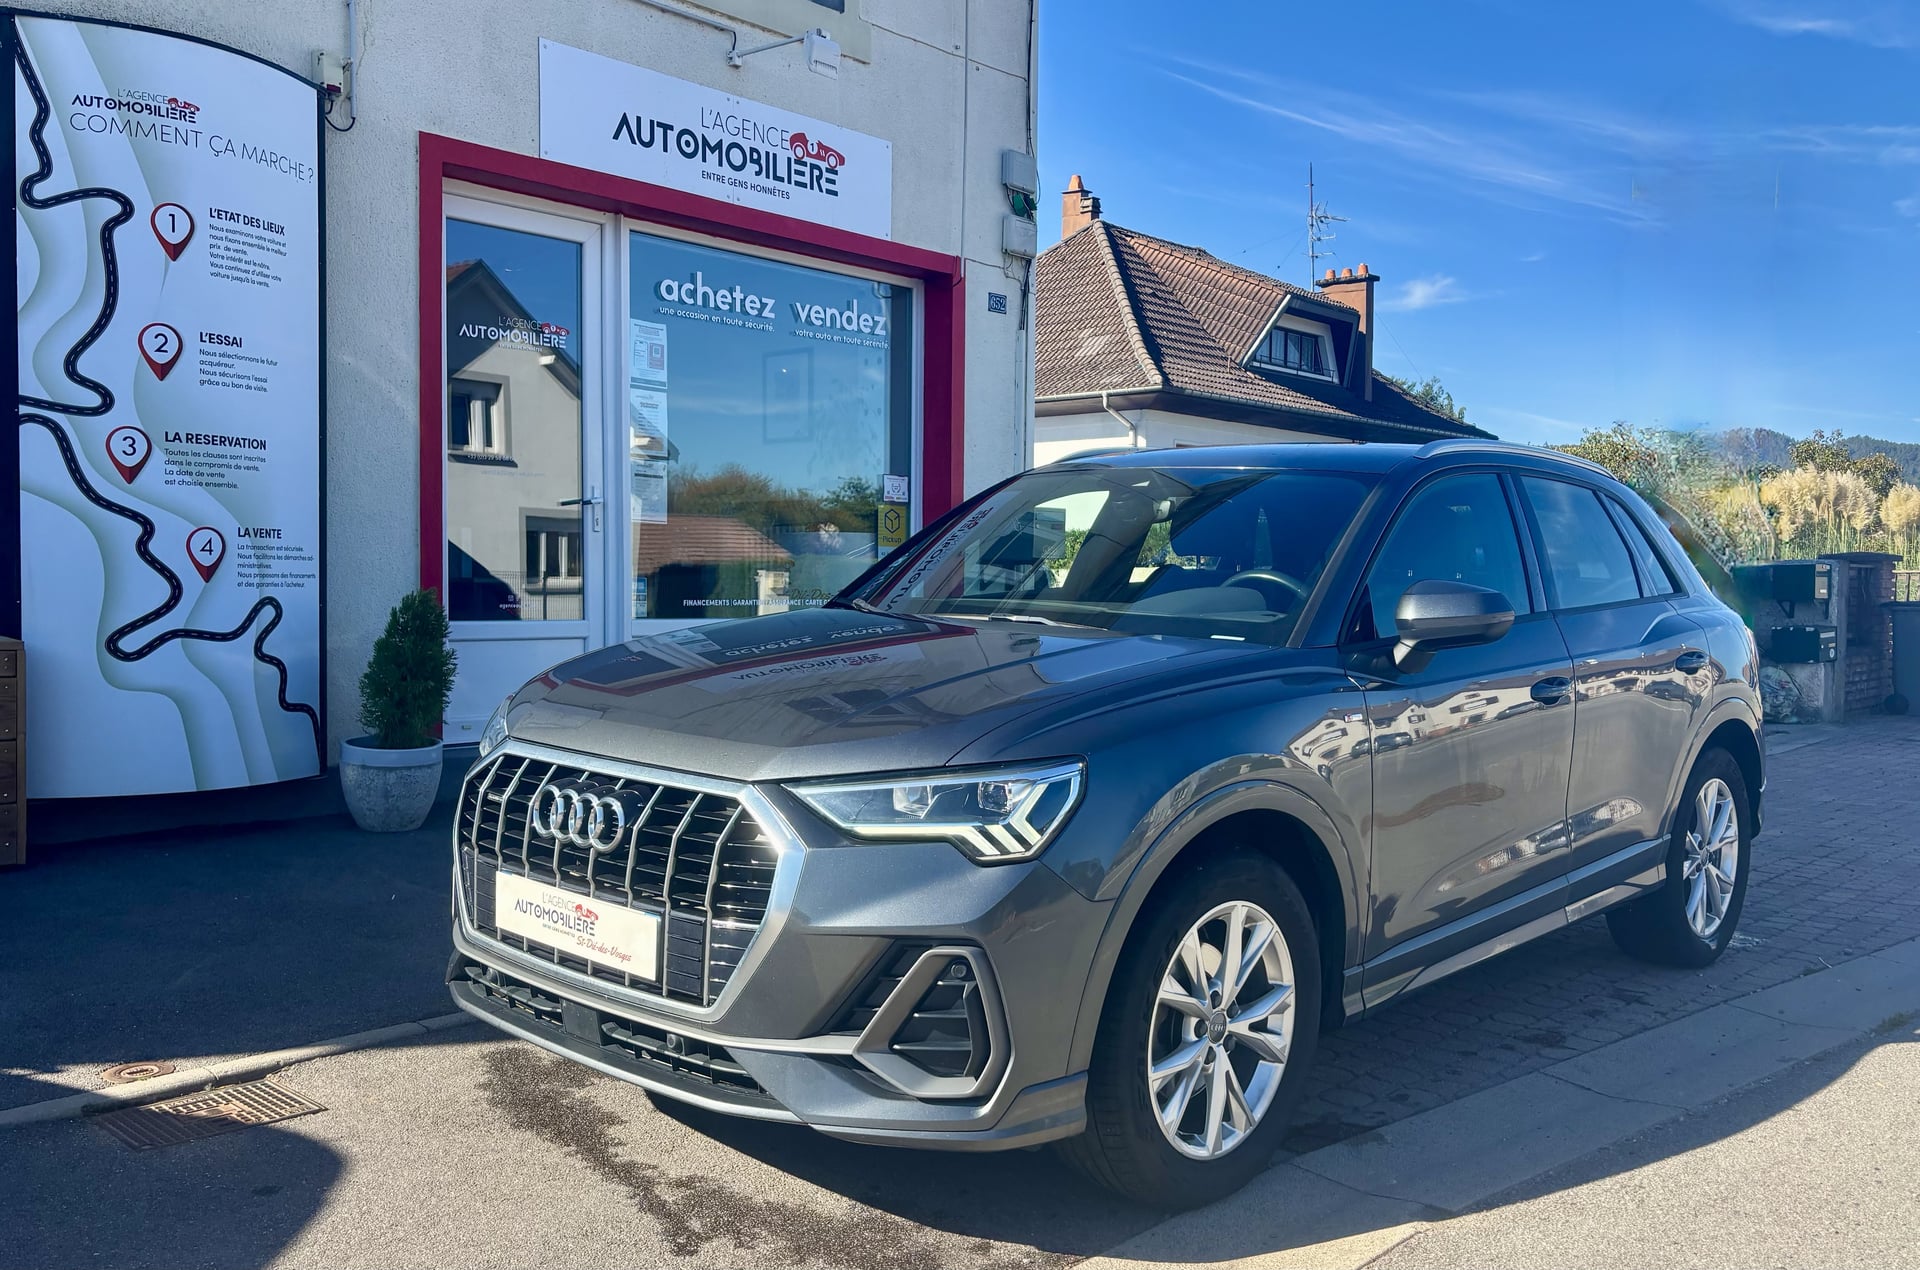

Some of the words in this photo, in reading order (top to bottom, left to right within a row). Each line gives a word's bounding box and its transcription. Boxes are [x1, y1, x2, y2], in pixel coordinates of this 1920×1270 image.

[118, 89, 168, 104] L'AGENCE
[70, 112, 203, 148] COMMENT
[209, 135, 236, 157] ÇA
[701, 107, 790, 151] L'AGENCE
[701, 170, 726, 184] ENTRE
[728, 178, 748, 190] GENS
[750, 182, 790, 199] HONNÊTES
[169, 214, 175, 233] 1
[209, 208, 241, 223] L'ETAT
[243, 215, 261, 228] DES
[262, 220, 285, 236] LIEUX
[209, 224, 224, 232] Nous
[225, 236, 240, 245] fixons
[242, 240, 265, 251] ensemble
[210, 252, 225, 260] Votre
[210, 261, 223, 269] Vous
[225, 264, 250, 274] continuez
[210, 271, 230, 279] voiture
[660, 272, 776, 318] achetez
[499, 316, 541, 330] L'AGENCE
[660, 307, 674, 315] une
[677, 310, 709, 320] occasion
[724, 318, 742, 326] toute
[795, 299, 886, 335] vendez
[154, 333, 168, 353] 2
[200, 332, 242, 348] L'ESSAI
[795, 329, 813, 337] votre
[816, 332, 831, 340] auto
[844, 336, 860, 344] toute
[200, 349, 217, 358] Nous
[219, 352, 259, 364] sélectionnons
[266, 358, 278, 366] futur
[200, 368, 217, 377] Nous
[219, 370, 250, 381] sécurisons
[200, 378, 220, 387] grâce
[122, 436, 136, 456] 3
[165, 431, 182, 443] LA
[186, 433, 266, 450] RESERVATION
[165, 449, 189, 457] Toutes
[202, 451, 228, 460] clauses
[244, 455, 266, 463] inscrites
[164, 458, 183, 467] dans
[185, 459, 192, 467] le
[194, 461, 232, 470] compromis
[234, 462, 242, 470] de
[176, 469, 193, 477] date
[178, 479, 203, 487] choisie
[238, 527, 251, 538] LA
[253, 528, 281, 539] VENTE
[200, 537, 213, 555] 4
[542, 892, 576, 912] L'AGENCE
